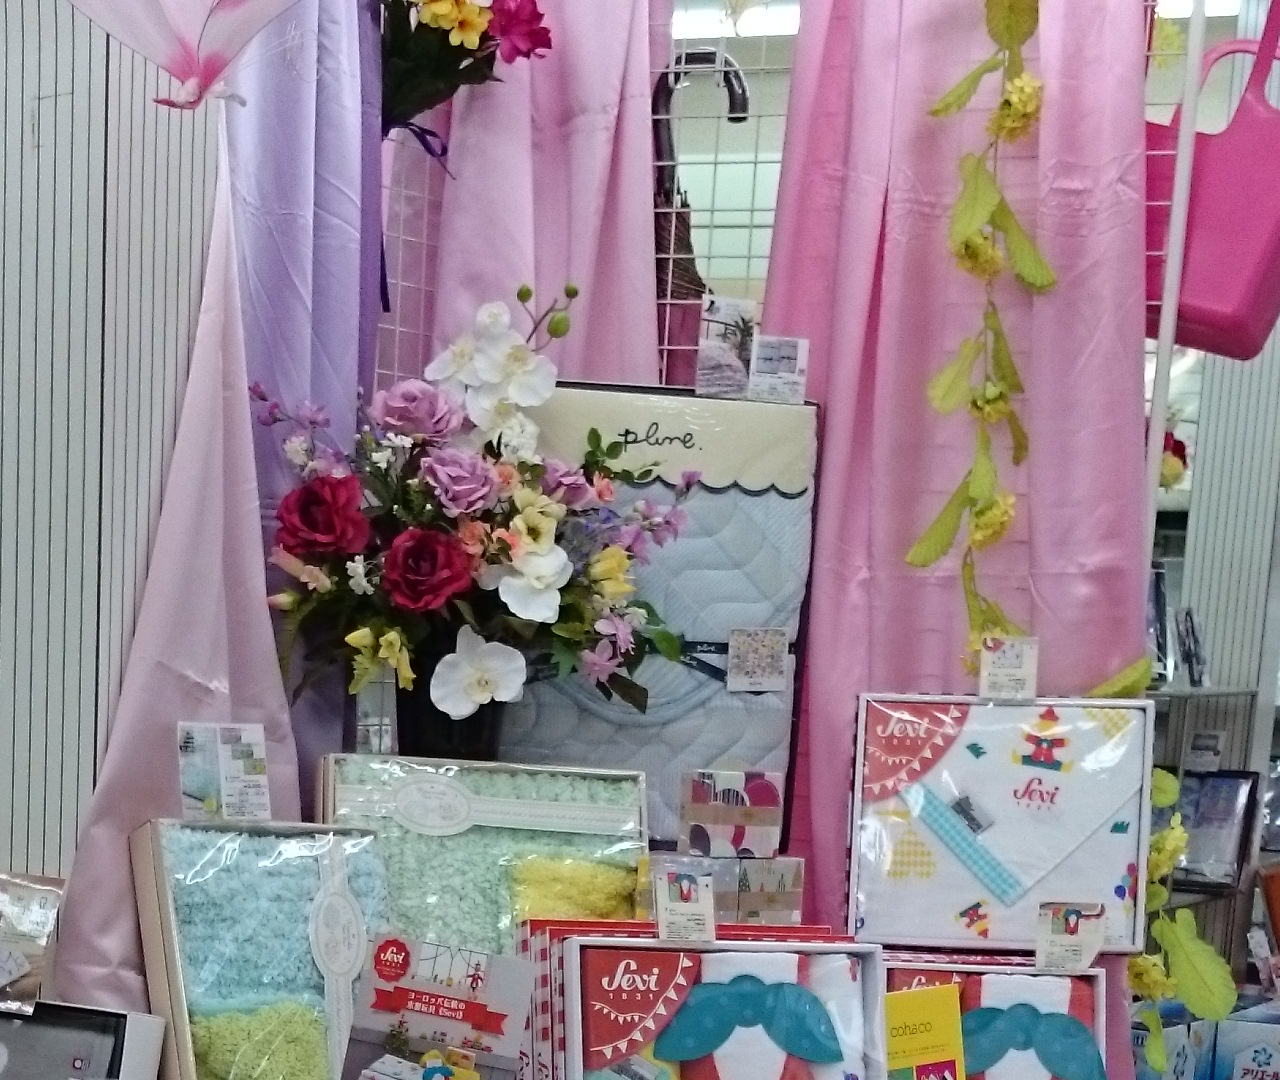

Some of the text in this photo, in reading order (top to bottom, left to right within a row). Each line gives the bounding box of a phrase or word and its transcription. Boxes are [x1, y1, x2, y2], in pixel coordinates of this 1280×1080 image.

[1013, 777, 1059, 806] Sevi
[380, 946, 405, 964] Sevi
[602, 960, 659, 991] Sevi
